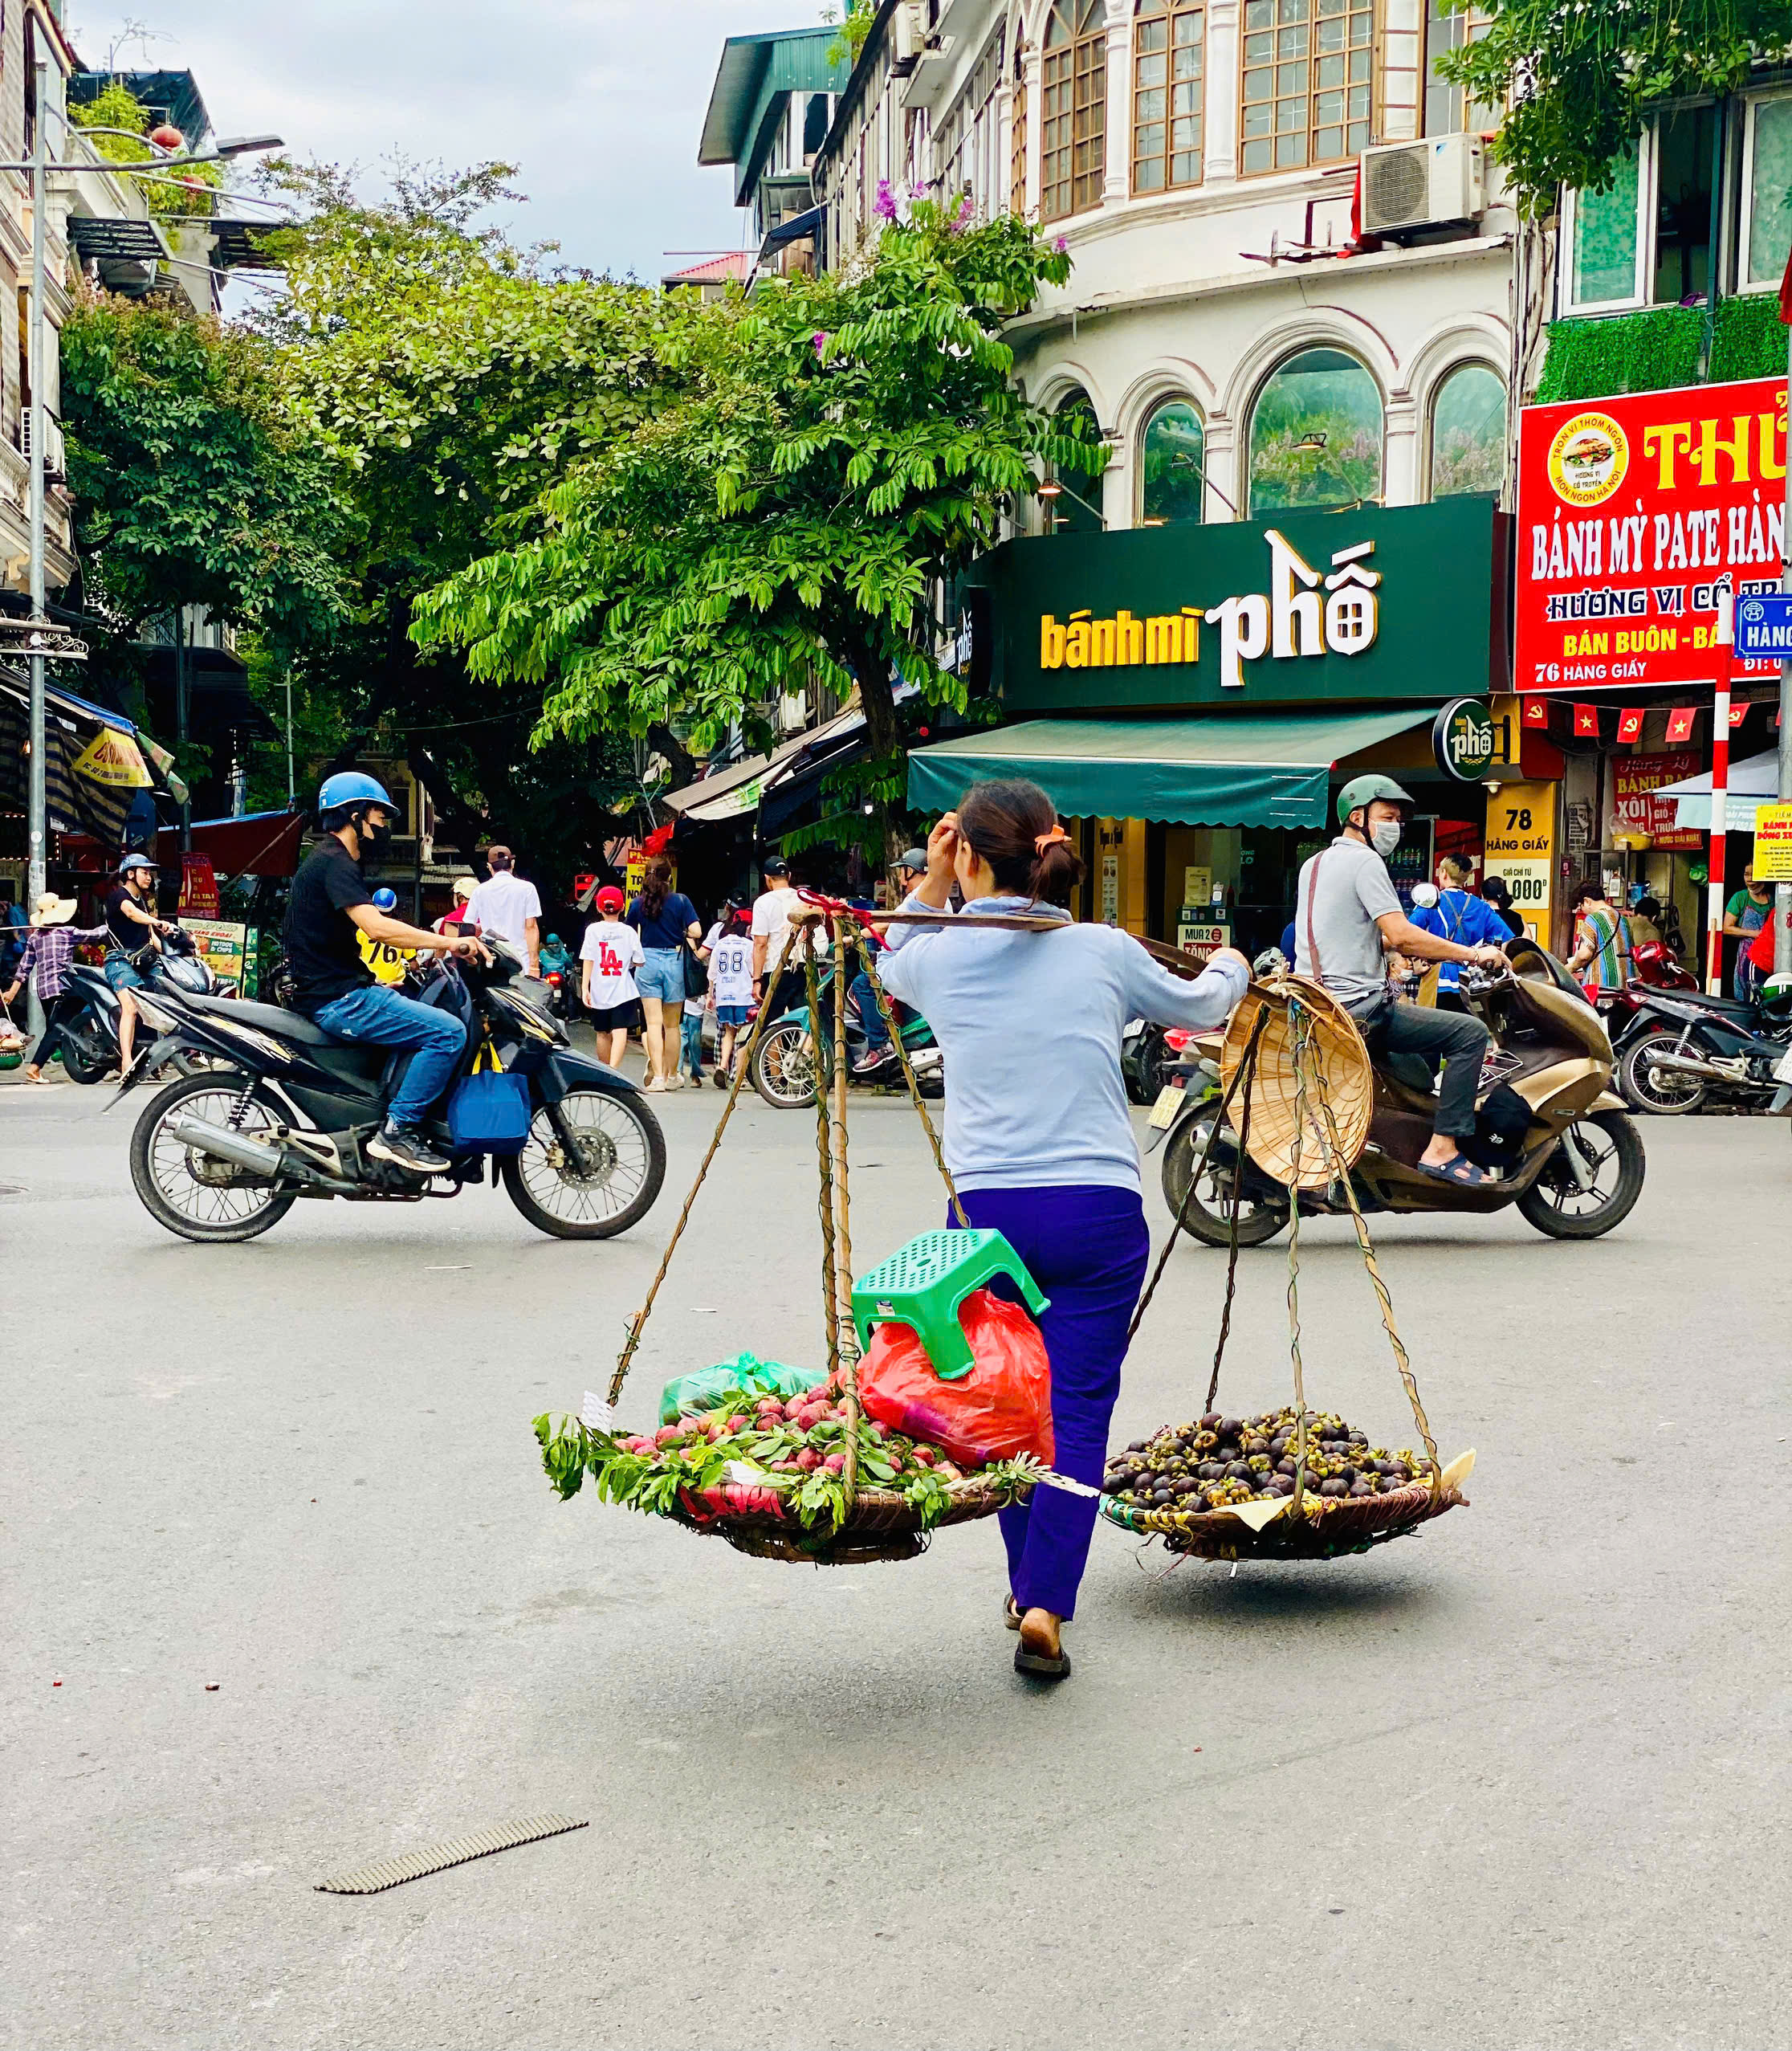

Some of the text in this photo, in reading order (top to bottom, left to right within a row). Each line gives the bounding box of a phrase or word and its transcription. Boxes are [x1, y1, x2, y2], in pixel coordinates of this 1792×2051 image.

[1531, 506, 1603, 580] BÁNH
[1608, 498, 1647, 575] MỲ
[1653, 508, 1721, 571] PATE
[1205, 528, 1382, 687] phố
[1548, 588, 1647, 622] HƯƠNG
[1654, 586, 1684, 618] VỊ
[1563, 630, 1608, 657] BÁN
[1615, 625, 1676, 654] BUÔN
[1535, 659, 1647, 682] 76 HÀNG GIẤY
[1450, 714, 1492, 764] phố
[1617, 773, 1660, 793] BÁNH
[1505, 809, 1532, 830] 78
[1618, 797, 1646, 818] XÔI
[1486, 835, 1550, 850] HÀNG GIẤY
[1185, 929, 1203, 940] MUA
[1205, 929, 1210, 940] 2
[369, 940, 397, 964] 76
[598, 941, 623, 977] LA
